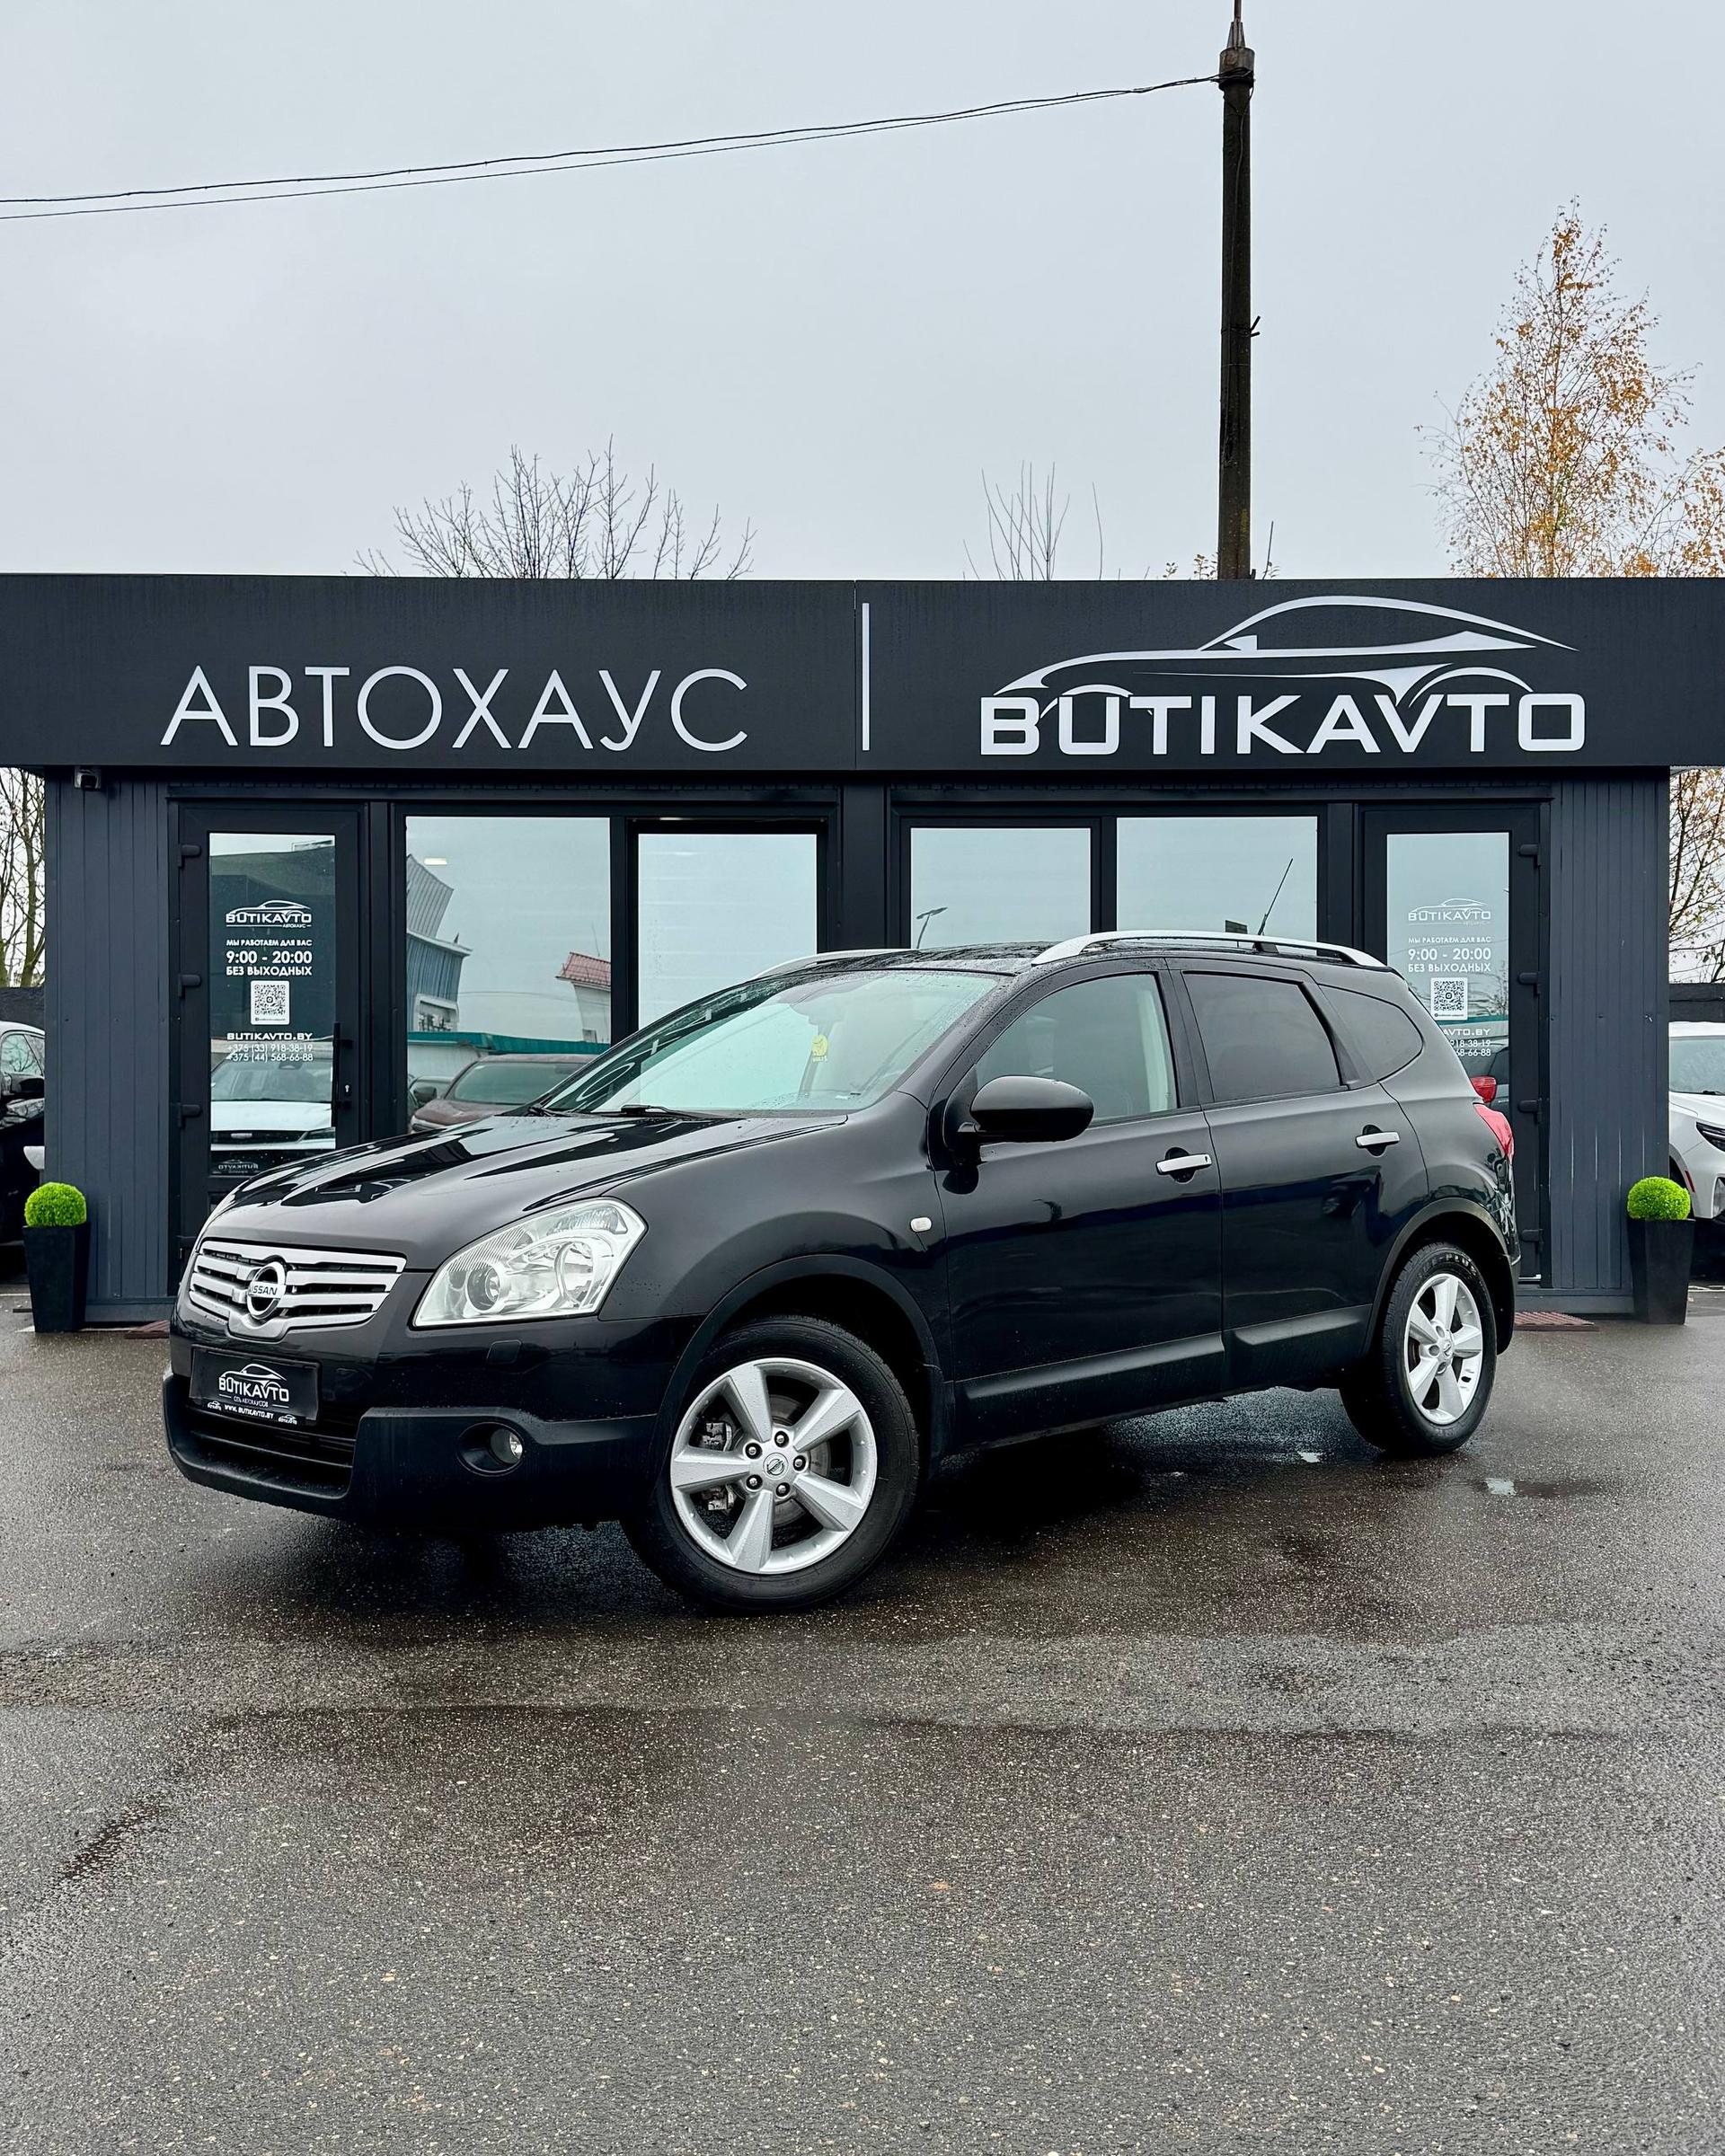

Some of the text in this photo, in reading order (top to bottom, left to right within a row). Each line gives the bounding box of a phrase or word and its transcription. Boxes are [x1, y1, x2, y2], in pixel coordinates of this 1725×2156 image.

[160, 665, 748, 752] АВТОХАУС
[980, 690, 1586, 755] BUTIKAVTO
[226, 912, 312, 923] BUTIKAVTO
[1408, 911, 1491, 922] BUTIKAVTO
[226, 950, 258, 964] 9:00
[271, 950, 313, 964] 20:00
[1408, 948, 1438, 961] 9:00
[1452, 947, 1492, 960] 20:00
[226, 966, 313, 977] БЕЗ ВЫХОДНЫХ
[1408, 962, 1491, 973] БЕЗ ВЫХОДНЫХ
[226, 1032, 313, 1041] BUTIKAVTO.BY
[1443, 1028, 1491, 1036] AVTO.BY
[270, 1043, 314, 1053] 918-38-19
[252, 1052, 269, 1064] (44)
[270, 1053, 314, 1062] 568-66-88
[218, 1376, 290, 1402] BUTIKAVTO
